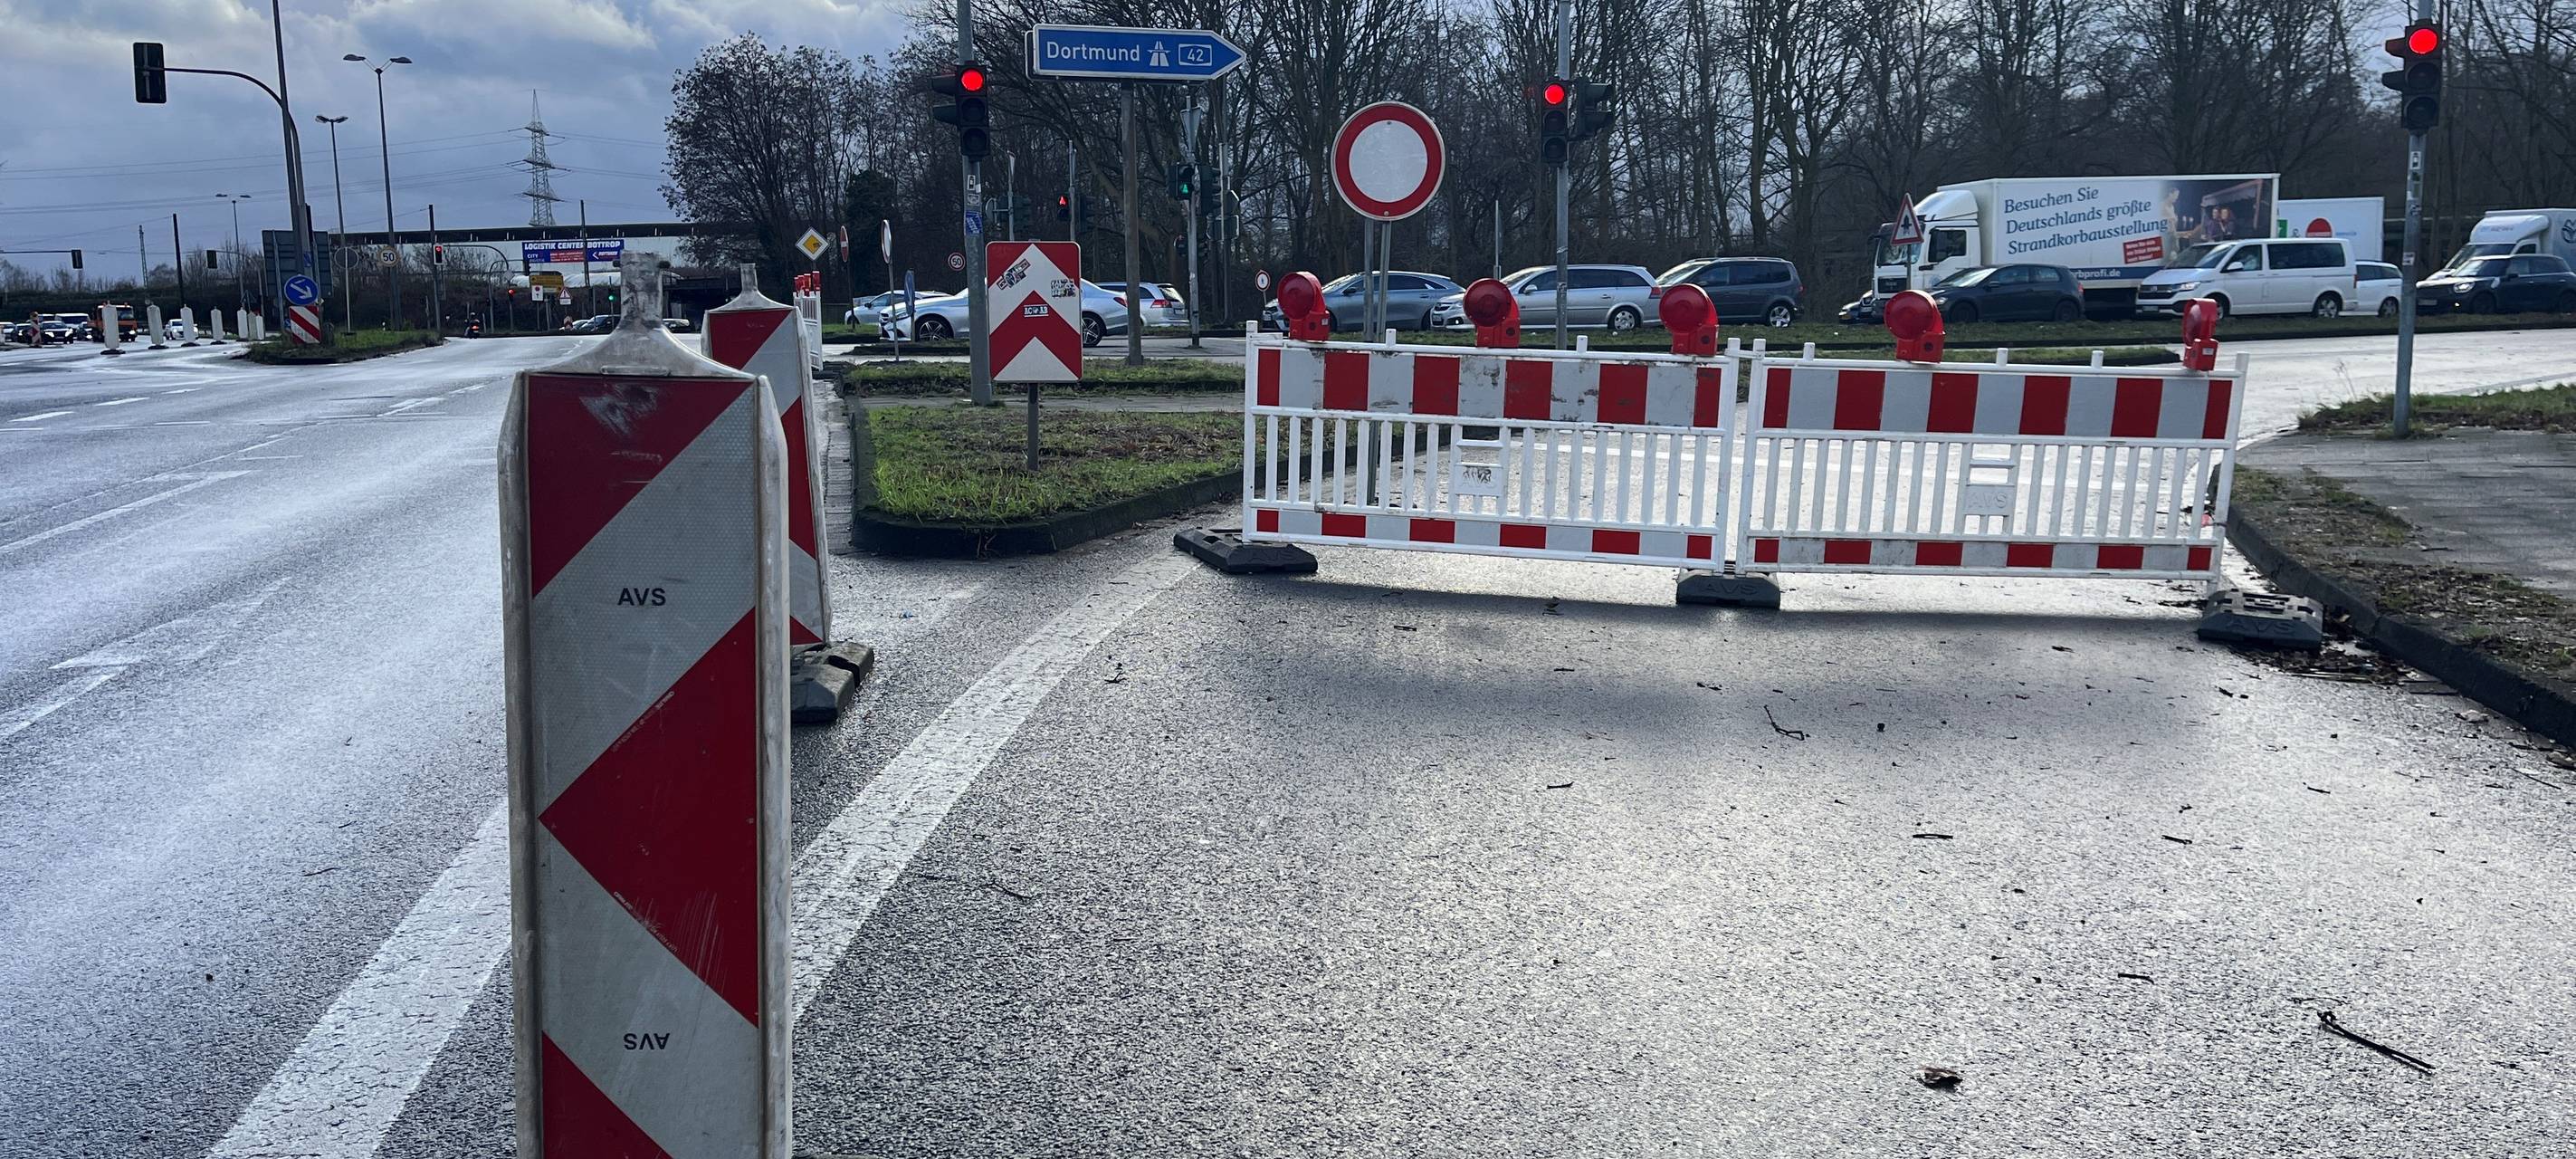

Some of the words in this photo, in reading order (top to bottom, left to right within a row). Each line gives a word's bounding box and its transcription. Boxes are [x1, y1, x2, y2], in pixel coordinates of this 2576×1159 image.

[1046, 41, 1140, 62] Dortmund
[1187, 49, 1204, 62] 42
[2004, 193, 2072, 213] Besuchen
[2077, 187, 2099, 202] Sie
[2006, 207, 2102, 234] Deutschlands
[2106, 199, 2151, 221] größte
[524, 242, 556, 250] LOGISTIK
[587, 240, 621, 248] BOTTROP
[2008, 219, 2168, 254] Strandkorbausstellung
[383, 253, 395, 262] 50
[2071, 269, 2121, 280] rbprofi.de
[617, 588, 666, 606] AVS
[1703, 582, 1759, 595] AVS
[624, 1033, 671, 1050] AVS
